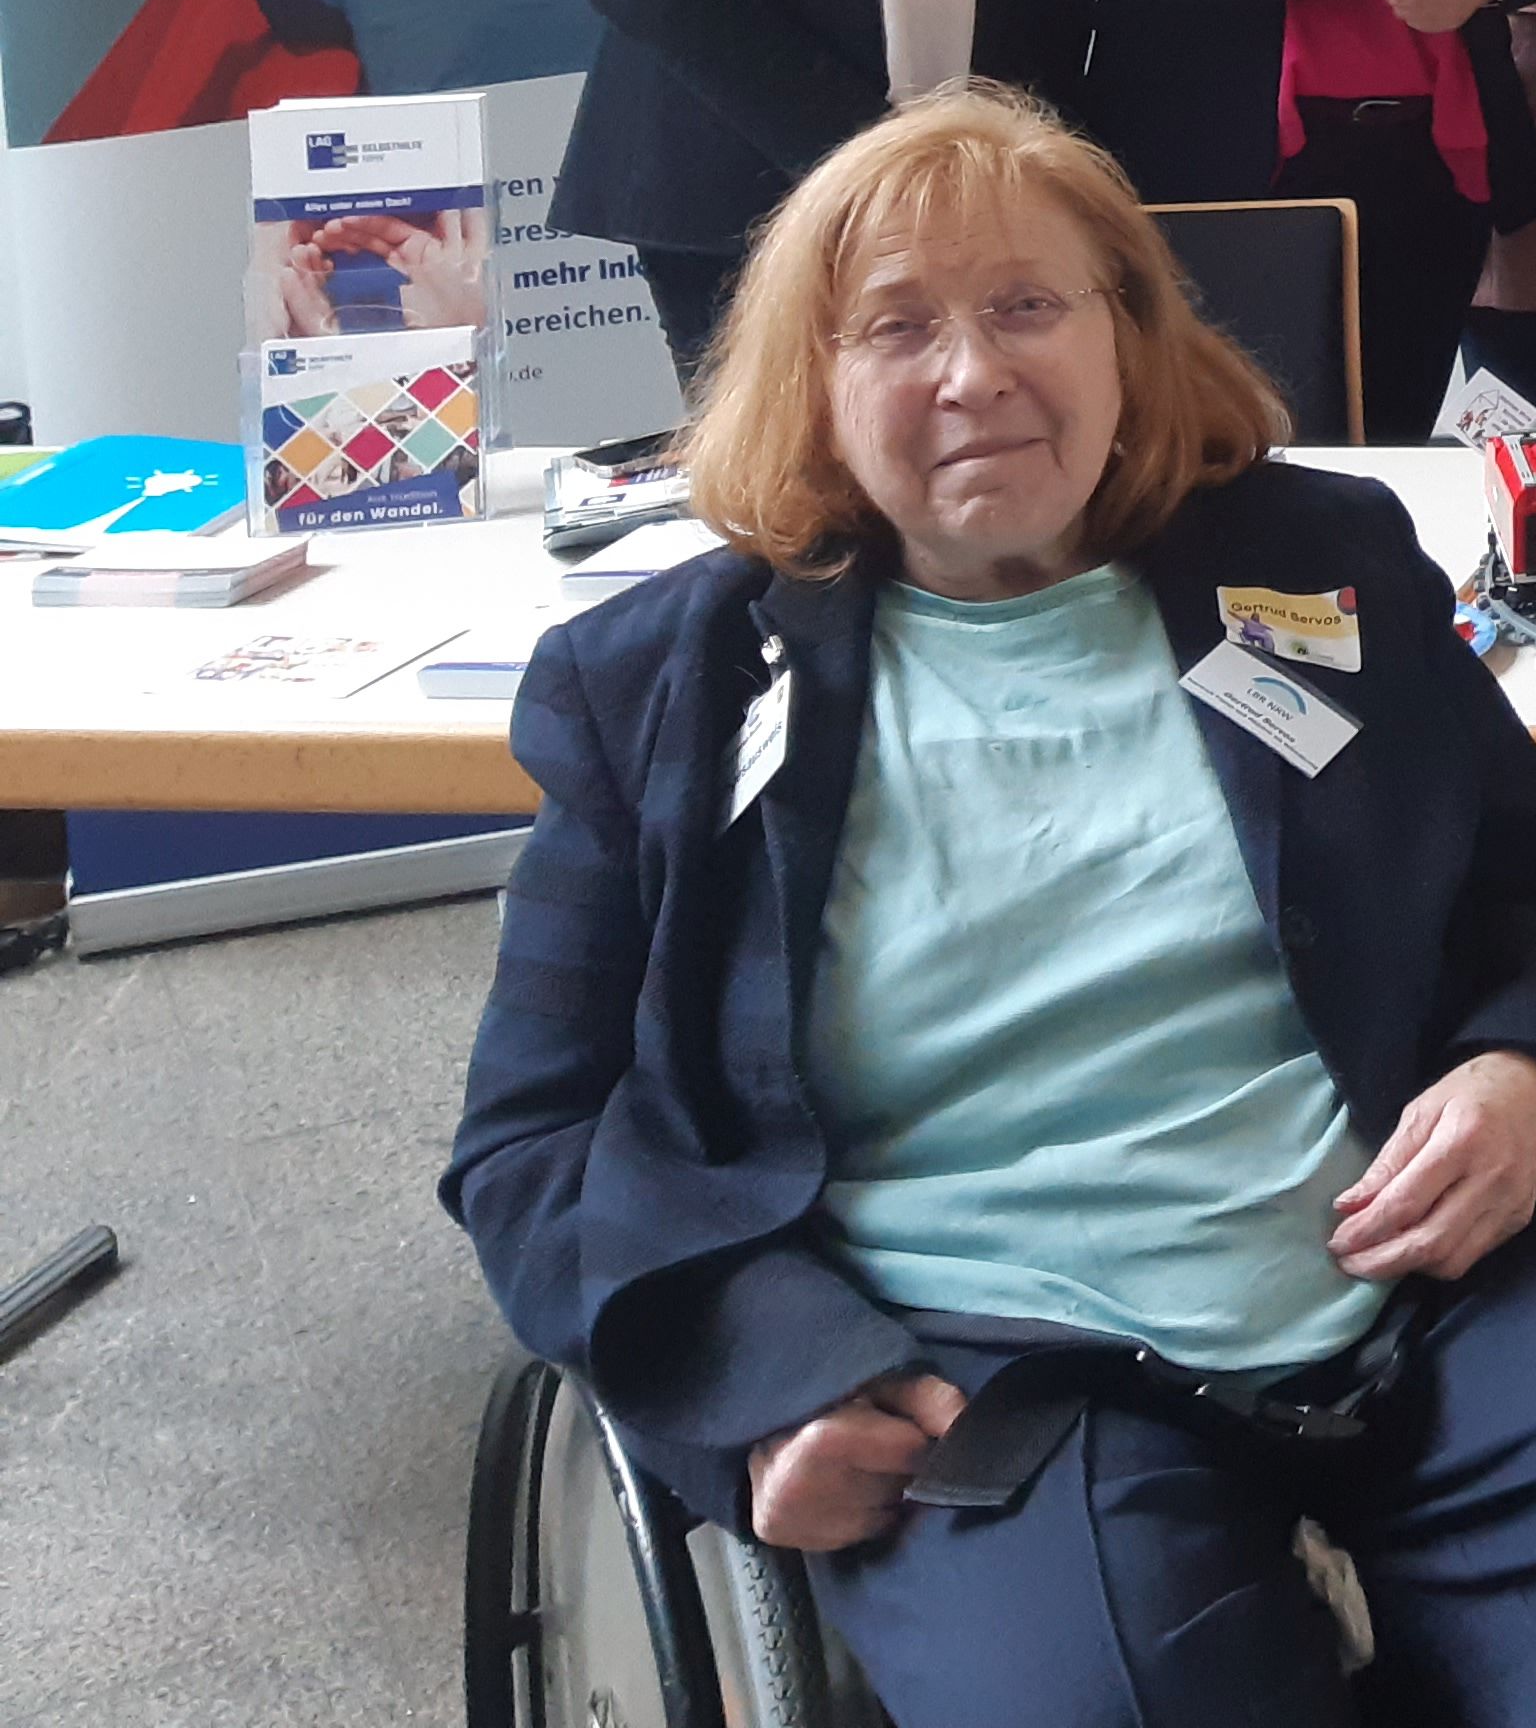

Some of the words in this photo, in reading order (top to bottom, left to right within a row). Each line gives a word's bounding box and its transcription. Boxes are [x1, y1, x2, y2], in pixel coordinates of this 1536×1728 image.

[308, 136, 332, 147] LAG
[513, 261, 591, 289] mehr
[299, 511, 326, 525] für
[331, 508, 364, 522] den
[370, 502, 444, 520] Wandel.
[1231, 602, 1287, 618] Gertrud
[1290, 612, 1342, 626] Servos
